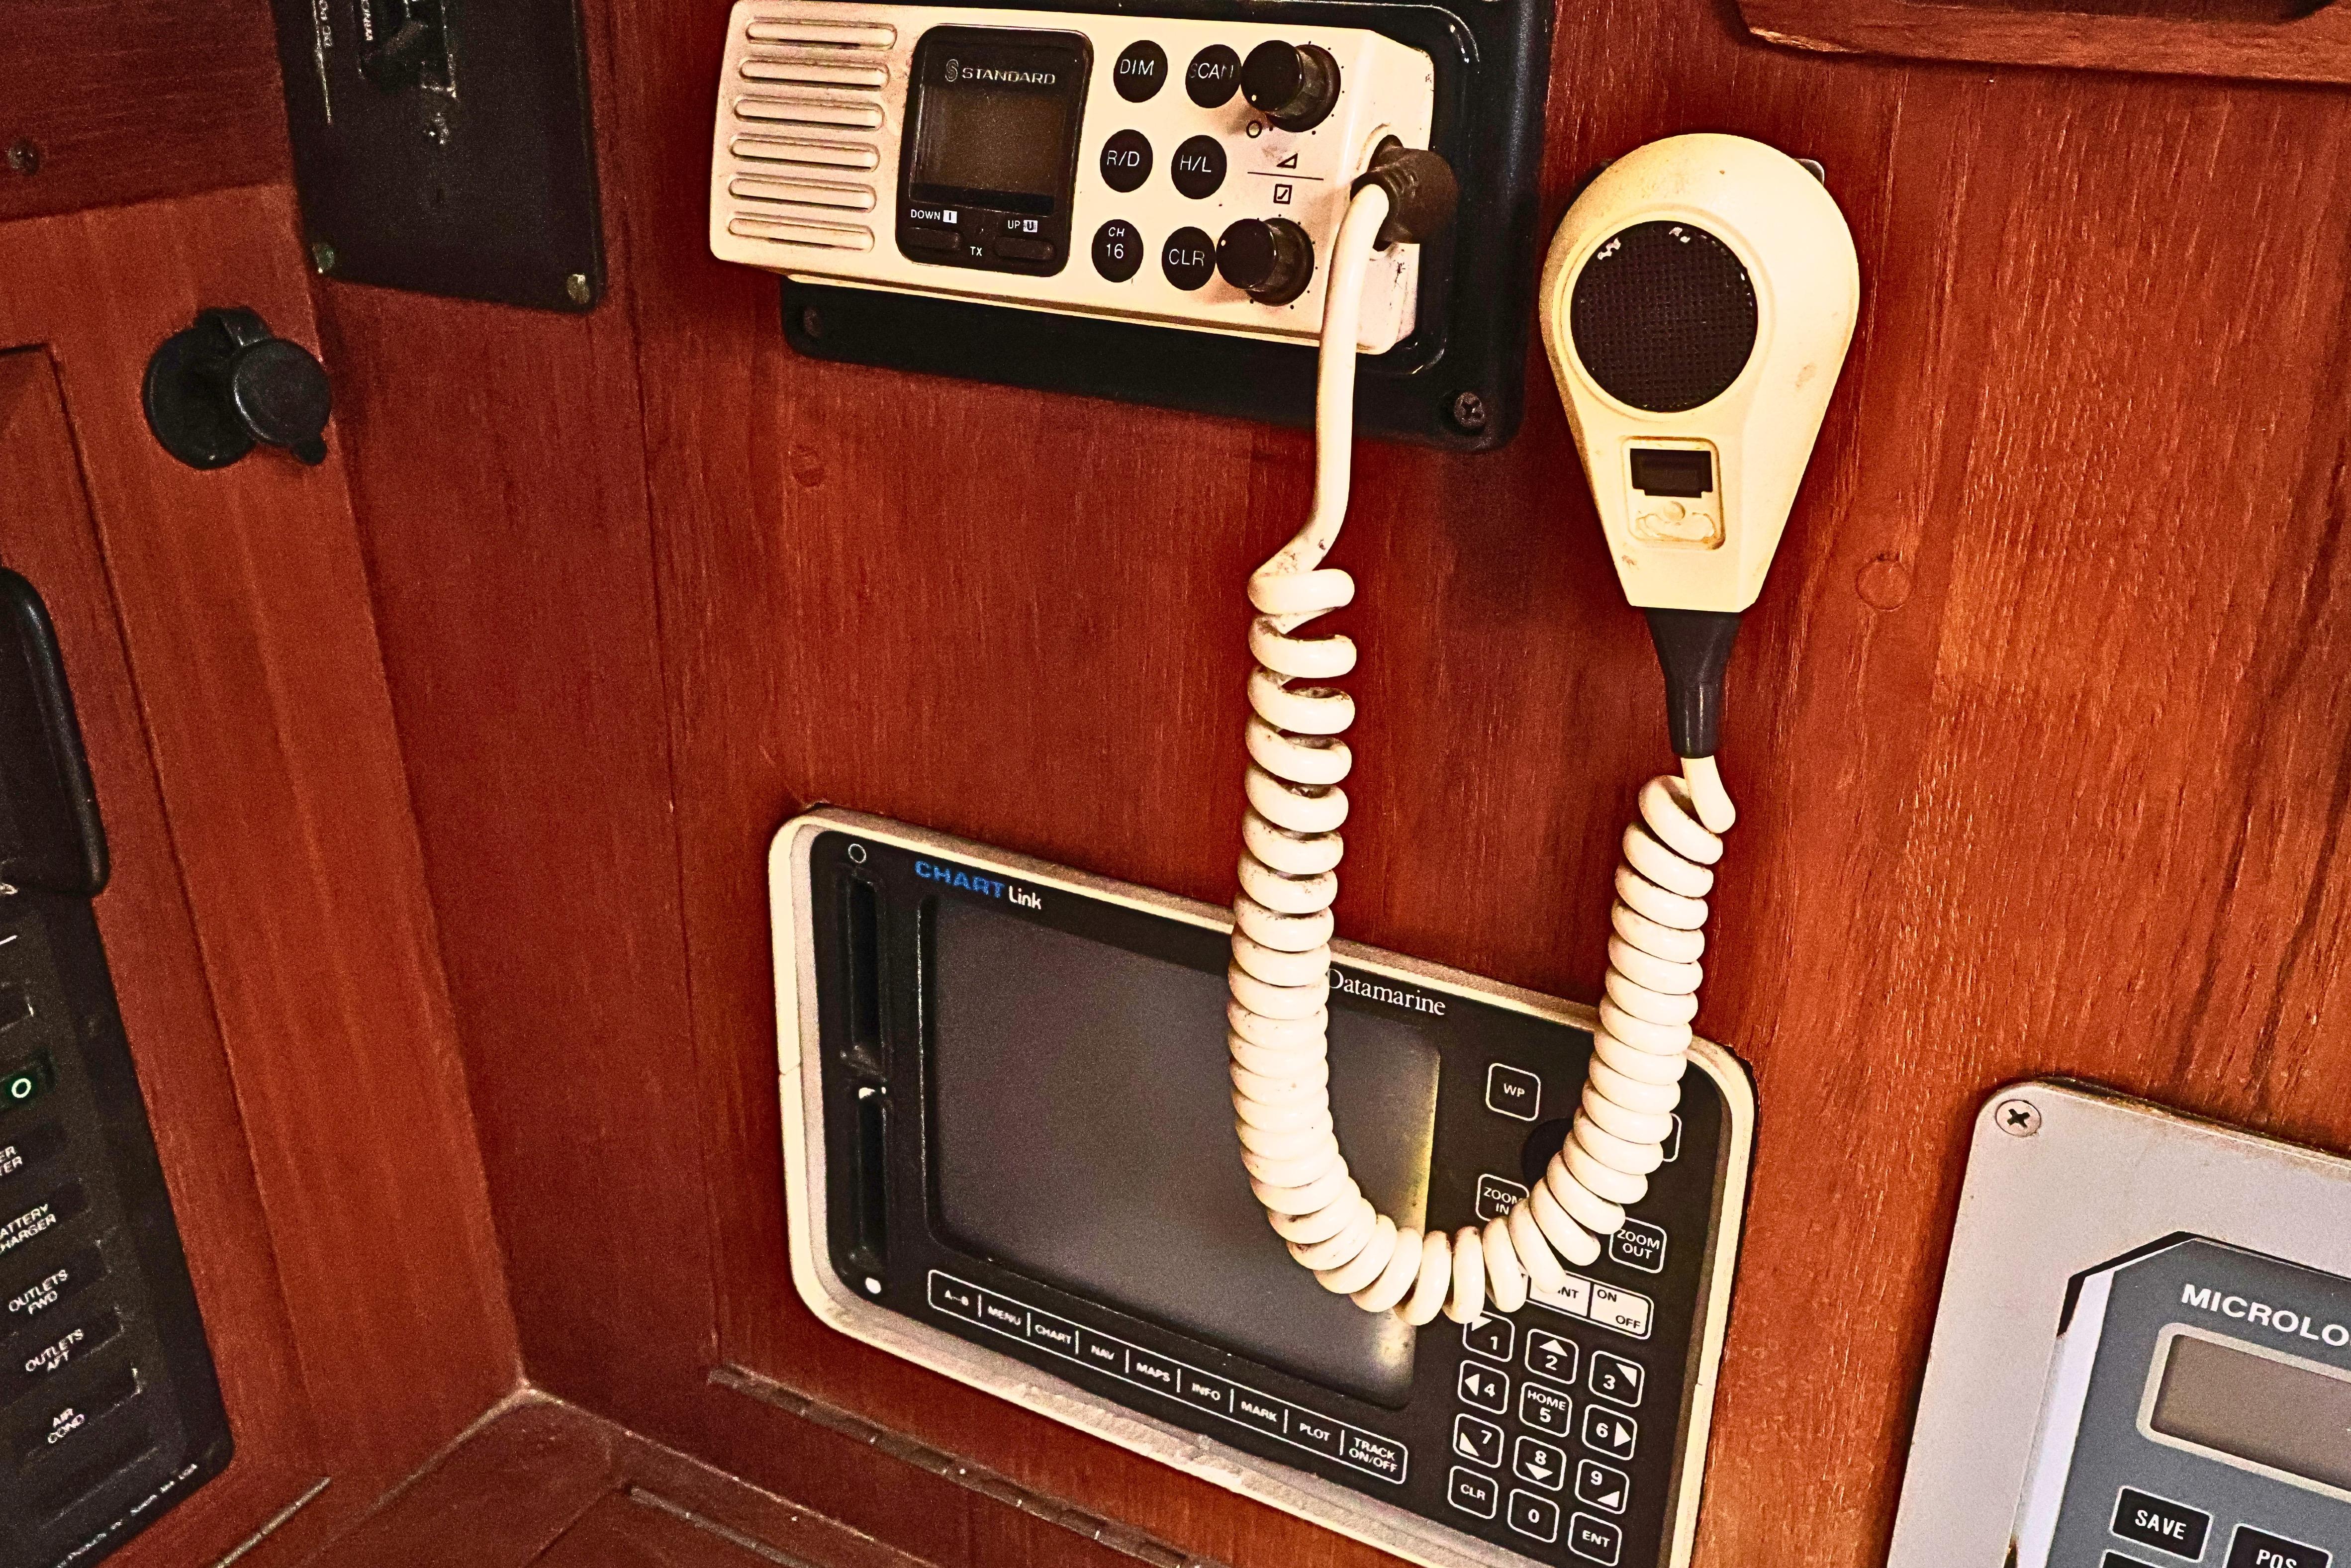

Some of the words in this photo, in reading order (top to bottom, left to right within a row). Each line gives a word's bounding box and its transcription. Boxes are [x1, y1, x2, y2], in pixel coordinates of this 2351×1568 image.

[962, 67, 1055, 85] STANDARD
[1120, 59, 1154, 76] DIM
[1189, 63, 1233, 80] SCAN
[1107, 150, 1139, 167] R/D
[1180, 155, 1212, 173] H/L
[911, 209, 940, 220] DOWN
[1008, 220, 1021, 229] UP
[1108, 227, 1125, 237] CH
[970, 246, 982, 257] TX
[1106, 243, 1124, 259] 16
[1169, 248, 1205, 266] CLR
[915, 861, 1005, 898] CHART
[1009, 886, 1041, 910] Link
[1326, 968, 1446, 1015] Datamarine
[1504, 1083, 1525, 1097] WP
[1496, 1203, 1509, 1215] IN
[1617, 1228, 1660, 1250] ZOOM
[1622, 1242, 1653, 1259] OUT
[9, 1269, 68, 1311] OUTLETS
[1557, 1286, 1579, 1299] NT
[1597, 1288, 1617, 1302] ON
[987, 1305, 1022, 1326] MENU
[1615, 1315, 1641, 1329] OFF
[2181, 1283, 2351, 1347] MICROLO
[1034, 1324, 1072, 1344] CHART
[25, 1328, 84, 1372] OUTLETS
[1490, 1336, 1498, 1350] 1
[1091, 1345, 1115, 1360] NAV
[47, 1350, 70, 1373] AFT
[1545, 1355, 1558, 1371] 2
[1136, 1362, 1171, 1382] MAPS
[1484, 1383, 1496, 1397] 4
[1603, 1374, 1616, 1390] 3
[1192, 1383, 1221, 1401] INFO
[1527, 1389, 1566, 1410] HOME
[53, 1408, 74, 1428] AIR
[1241, 1401, 1277, 1422] MARK
[1540, 1410, 1551, 1423] 5
[48, 1414, 85, 1443] COND
[1300, 1423, 1330, 1441] PLOT
[1481, 1430, 1492, 1444] 7
[1596, 1423, 1608, 1438] 6
[1355, 1437, 1395, 1461] TRACK
[1535, 1450, 1547, 1465] 8
[1349, 1448, 1398, 1473] ON/OFF
[1591, 1471, 1602, 1485] 9
[1460, 1484, 1486, 1500] CLR
[1528, 1509, 1540, 1523] 0
[2135, 1509, 2187, 1540] SAVE
[1582, 1530, 1610, 1547] ENT
[2256, 1549, 2297, 1568] POS
